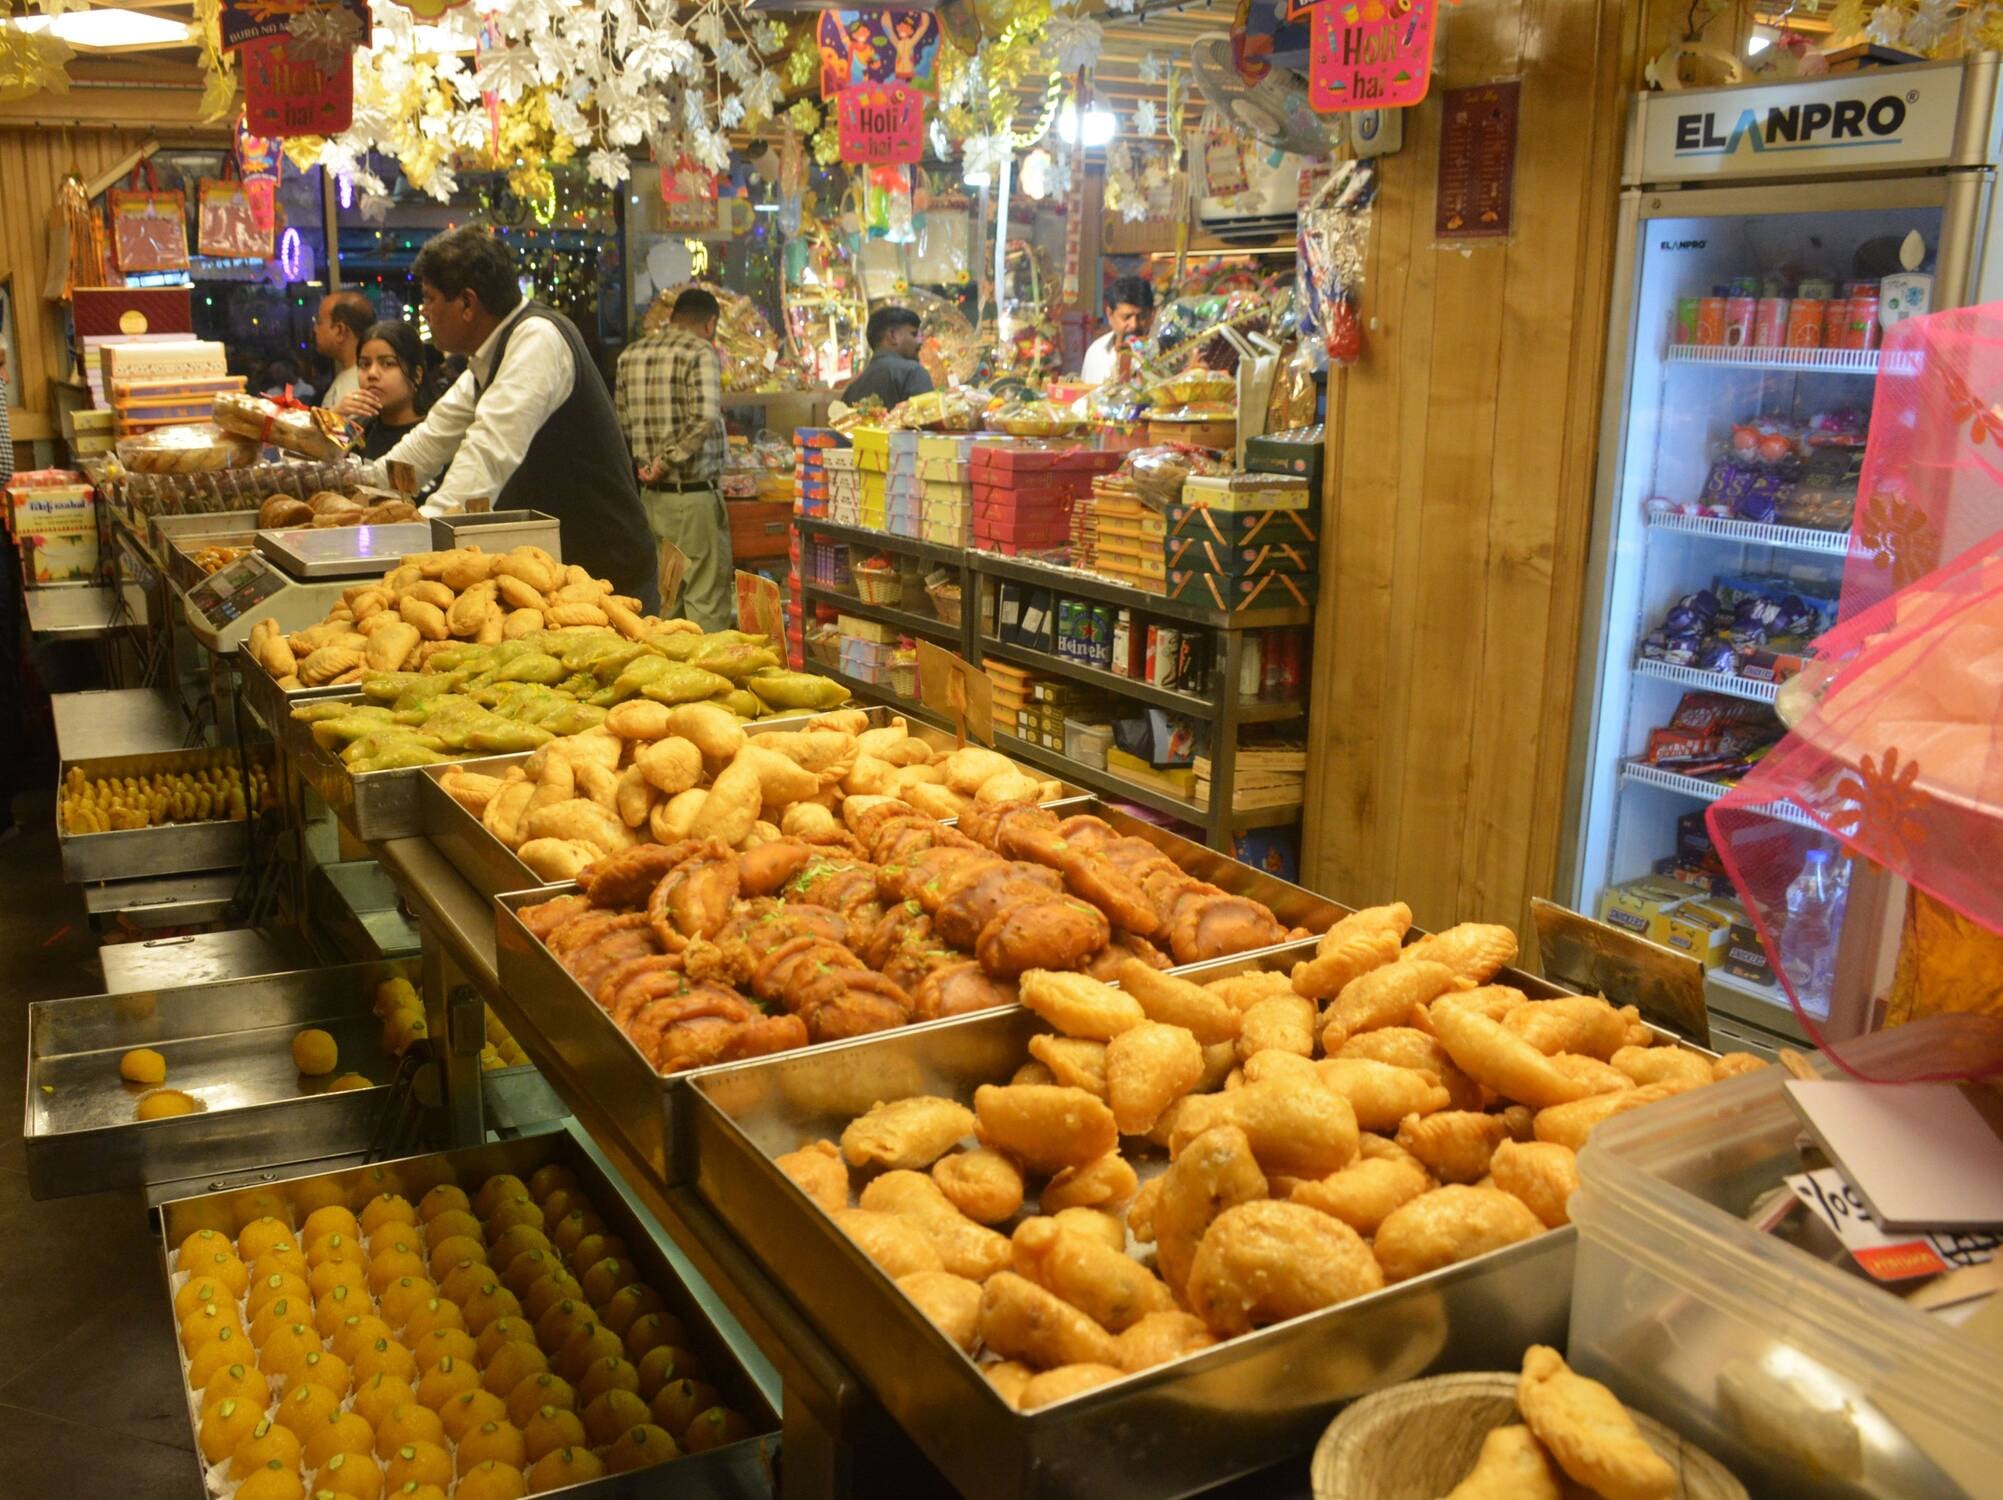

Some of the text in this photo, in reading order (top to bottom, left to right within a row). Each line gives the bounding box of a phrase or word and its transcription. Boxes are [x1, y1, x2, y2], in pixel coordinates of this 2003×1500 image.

[1343, 23, 1399, 66] Holi
[1353, 67, 1385, 99] hai
[860, 107, 899, 134] Holi
